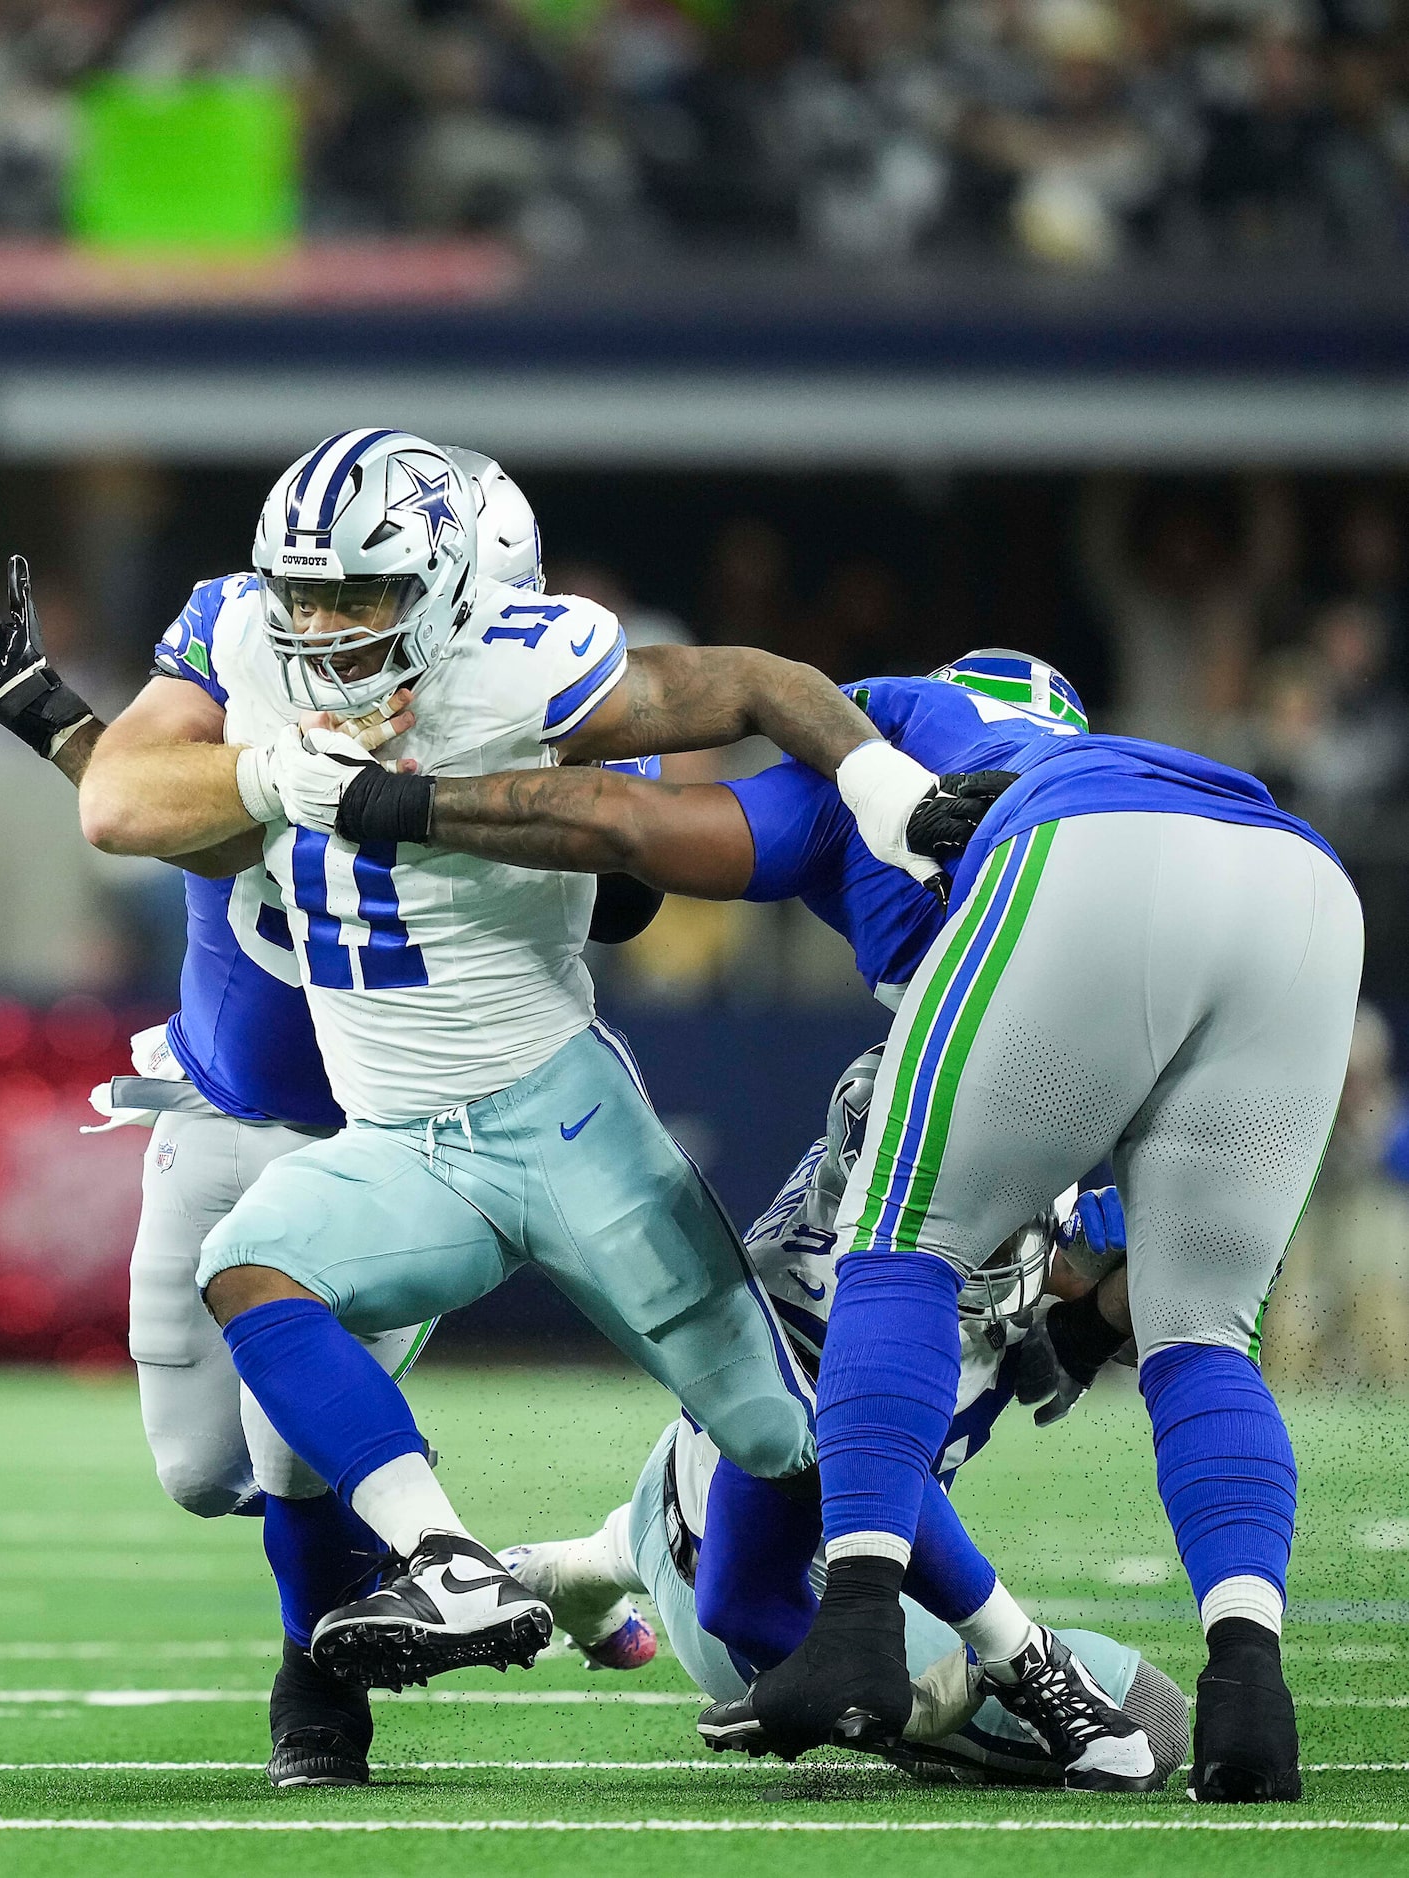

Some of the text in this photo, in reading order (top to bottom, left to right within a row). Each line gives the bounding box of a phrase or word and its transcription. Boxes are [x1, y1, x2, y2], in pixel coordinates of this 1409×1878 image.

[282, 555, 328, 566] COWBOYS
[481, 604, 570, 649] 11
[292, 824, 429, 989] 11
